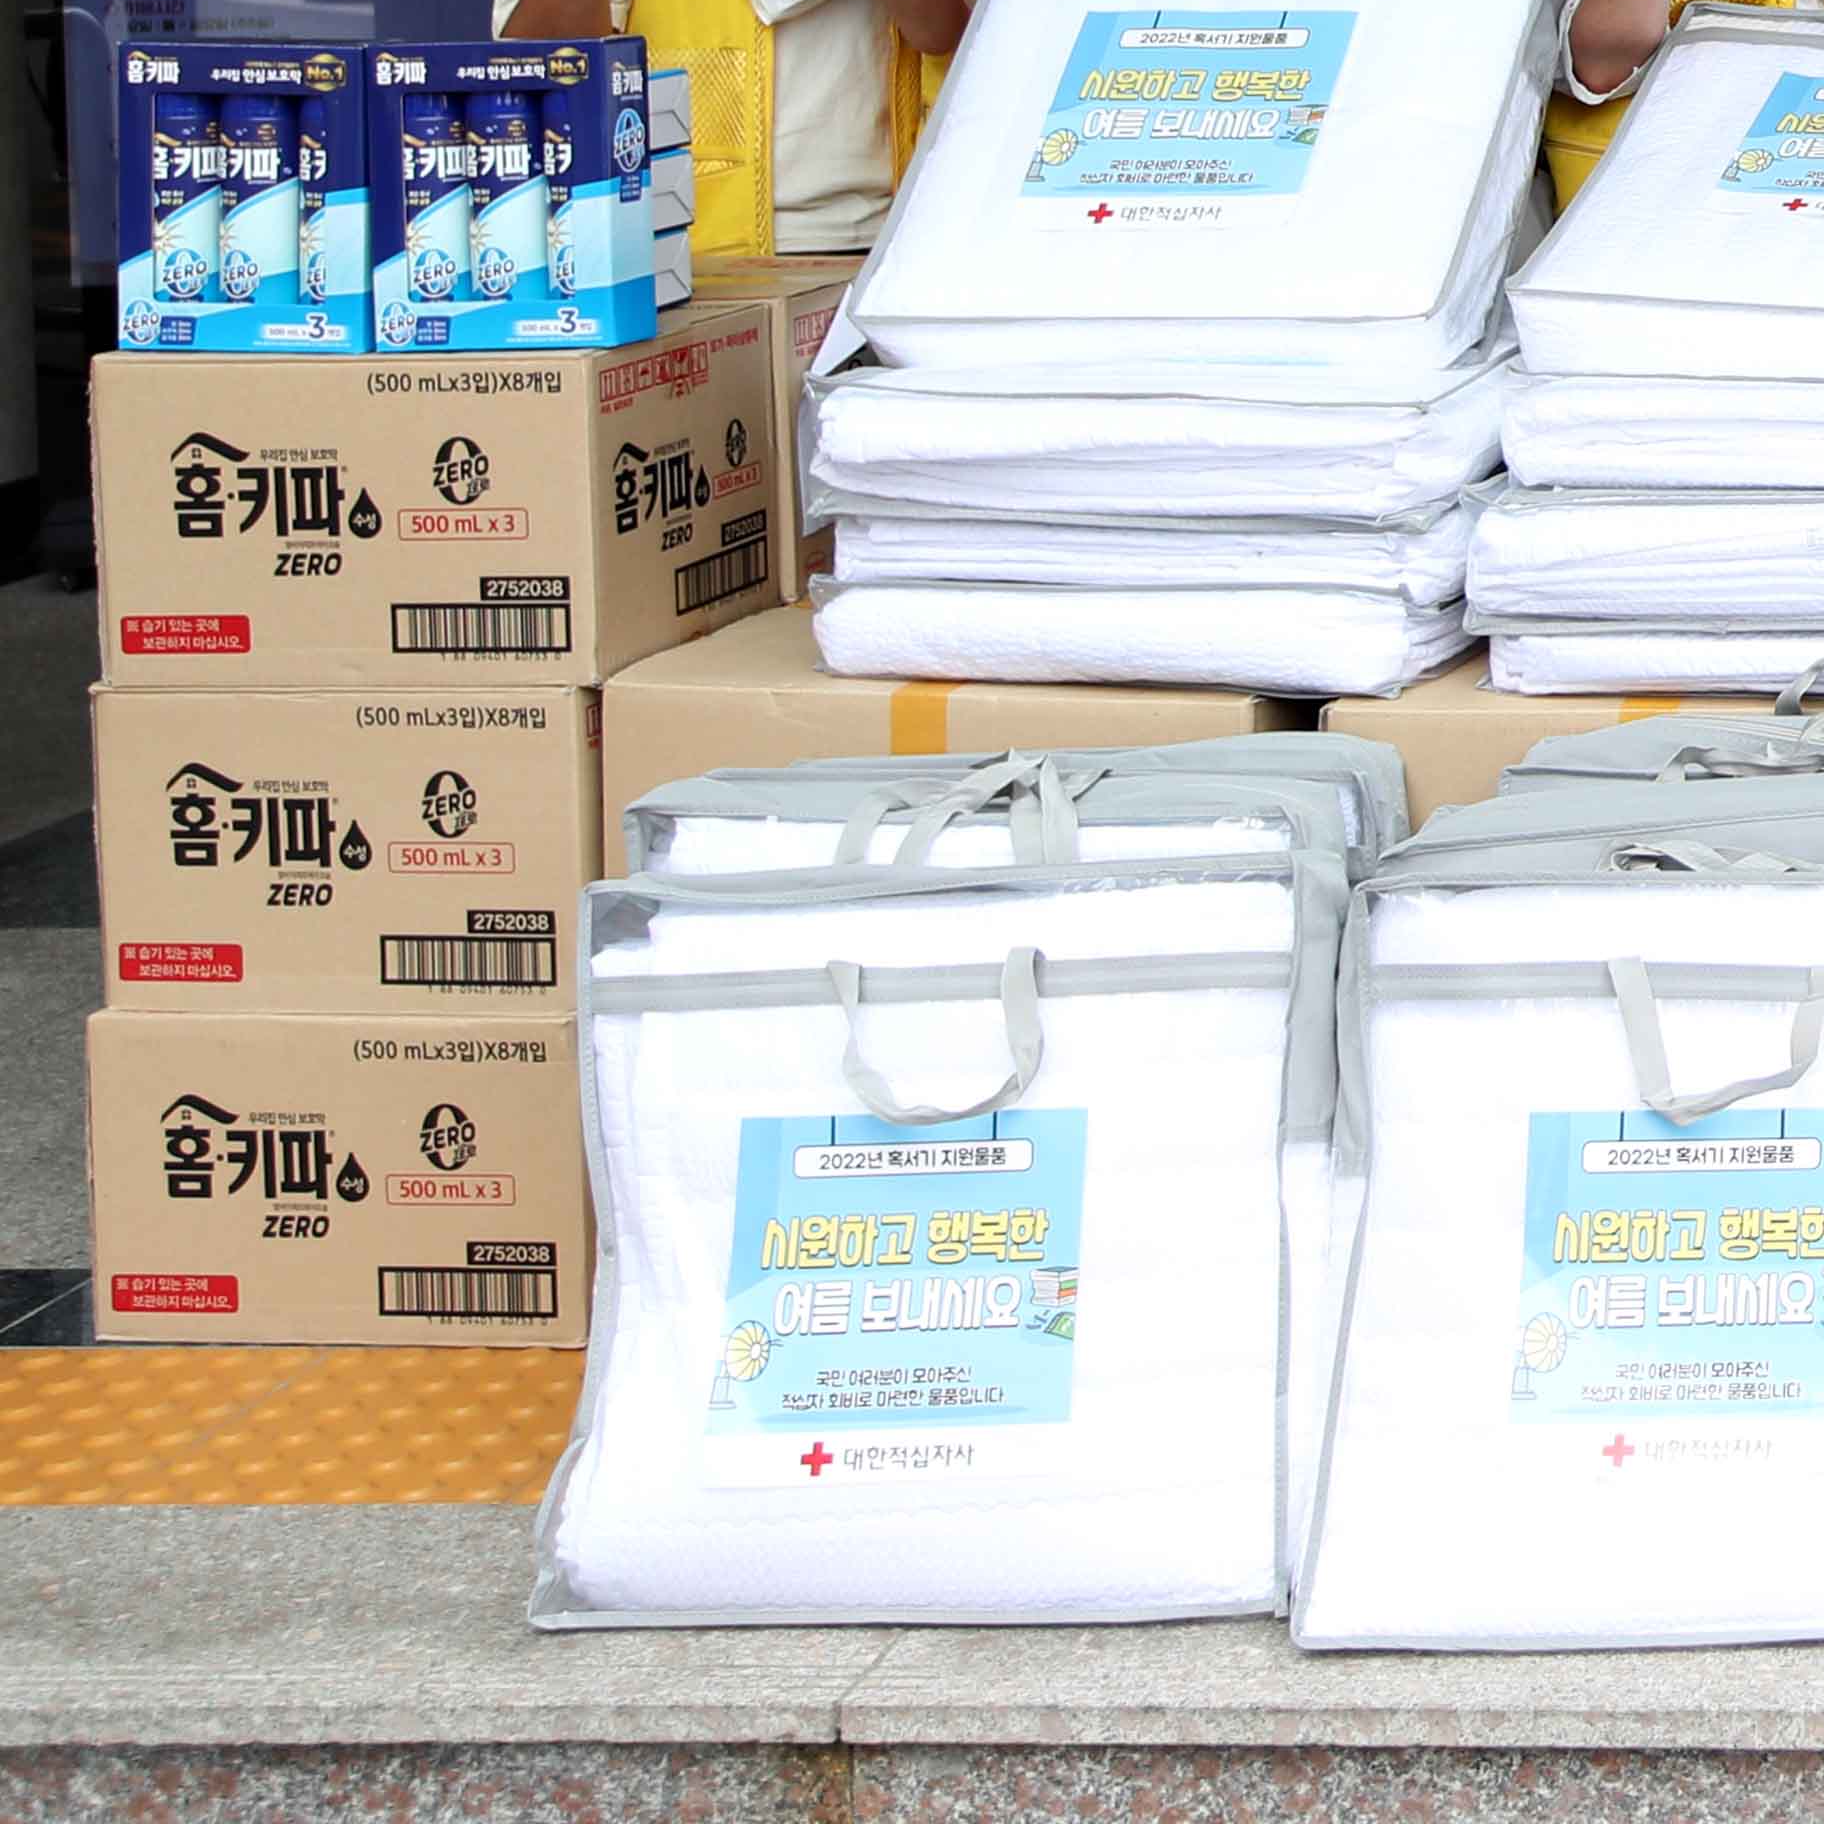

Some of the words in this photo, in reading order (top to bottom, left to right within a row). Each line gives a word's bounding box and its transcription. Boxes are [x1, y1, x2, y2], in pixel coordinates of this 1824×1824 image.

[1077, 69, 1206, 102] 시원하고
[1211, 68, 1312, 101] 행복한
[1082, 108, 1150, 139] 여름
[1151, 108, 1281, 139] 보내세요
[162, 261, 208, 282] ZERO
[123, 312, 159, 331] ZERO
[380, 314, 416, 332] ZERO
[367, 374, 412, 395] (500
[432, 454, 490, 488] ZERO
[411, 515, 448, 533] 500
[455, 515, 483, 533] mL
[488, 519, 502, 533] x
[504, 515, 515, 533] 3
[661, 524, 693, 552] ZERO
[274, 553, 343, 576] ZERO
[486, 579, 565, 597] 2752038
[356, 707, 400, 728] (500
[422, 788, 477, 819] ZERO
[473, 913, 549, 931] 2752038
[353, 1041, 397, 1061] (500
[819, 1150, 886, 1170] 2022년
[888, 1149, 937, 1169] 혹서기
[942, 1147, 1007, 1168] 지원물품
[263, 1216, 329, 1238] ZERO
[1553, 1209, 1708, 1264] 시원하고
[760, 1212, 917, 1270] 시원하고
[927, 1207, 1050, 1264] 행복한
[473, 1245, 550, 1262] 2752038
[773, 1280, 853, 1336] 여름
[860, 1275, 1022, 1333] 보내세요
[1568, 1274, 1648, 1330] 여름
[1656, 1271, 1816, 1327] 보내세요
[816, 1369, 847, 1387] 국민
[849, 1368, 909, 1386] 여러분이
[912, 1366, 972, 1385] 모아주신
[843, 1444, 975, 1472] 대한적십자사
